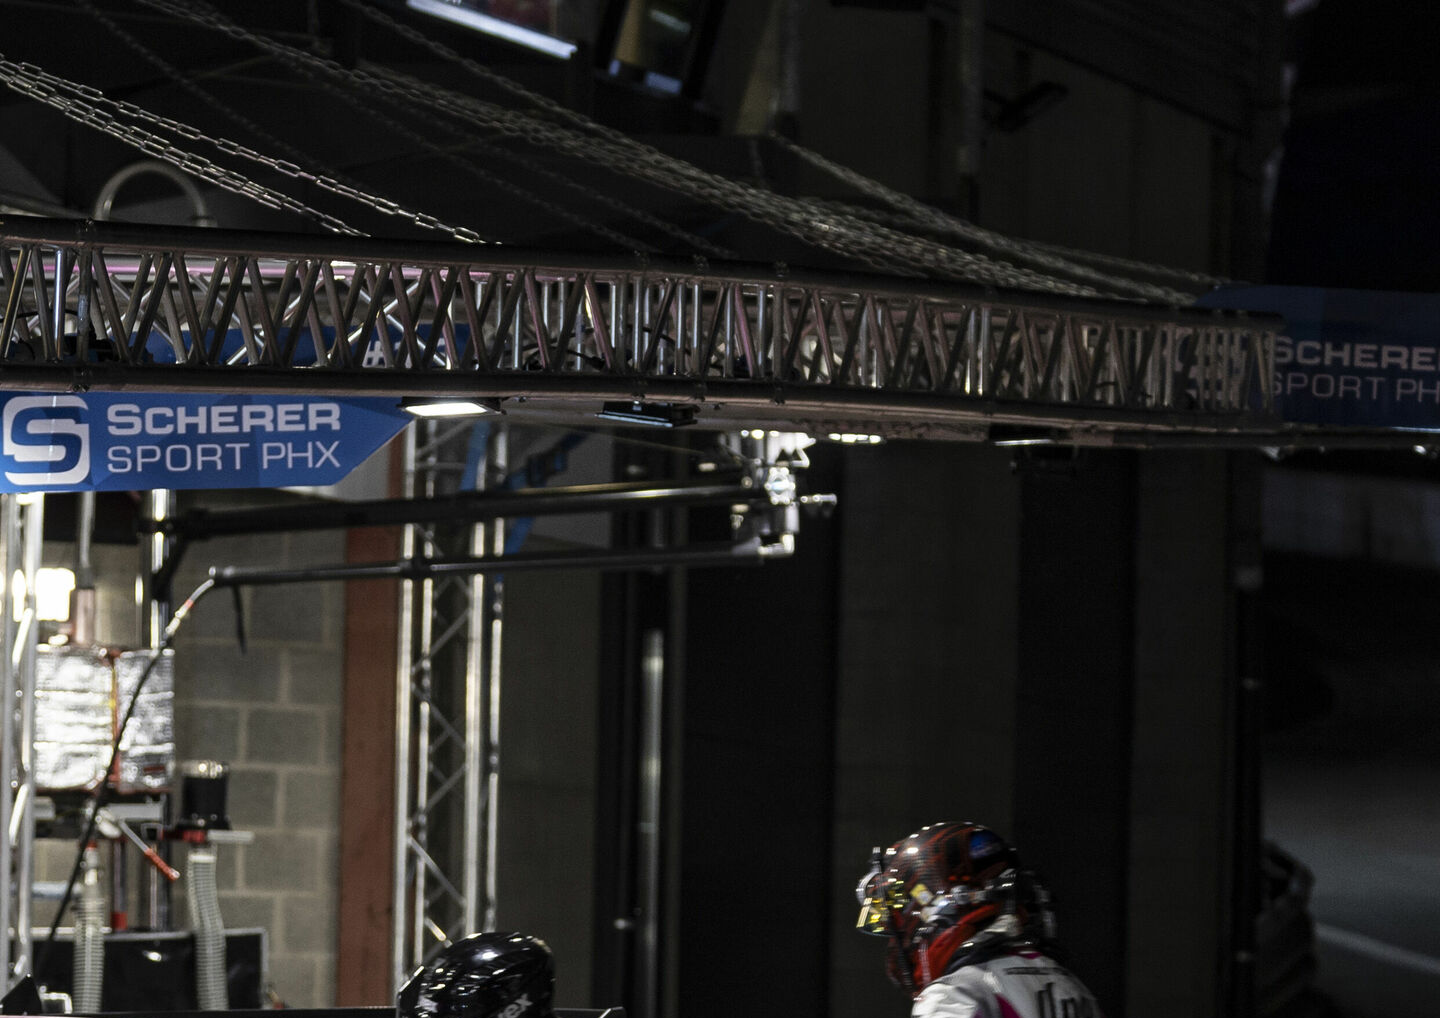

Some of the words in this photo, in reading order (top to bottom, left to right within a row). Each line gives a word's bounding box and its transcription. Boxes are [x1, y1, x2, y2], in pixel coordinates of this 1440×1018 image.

[1273, 335, 1440, 372] SCHERE
[1396, 377, 1440, 404] PH
[107, 402, 342, 436] SCHERER
[107, 442, 250, 474] SPORT
[262, 440, 342, 470] PHX
